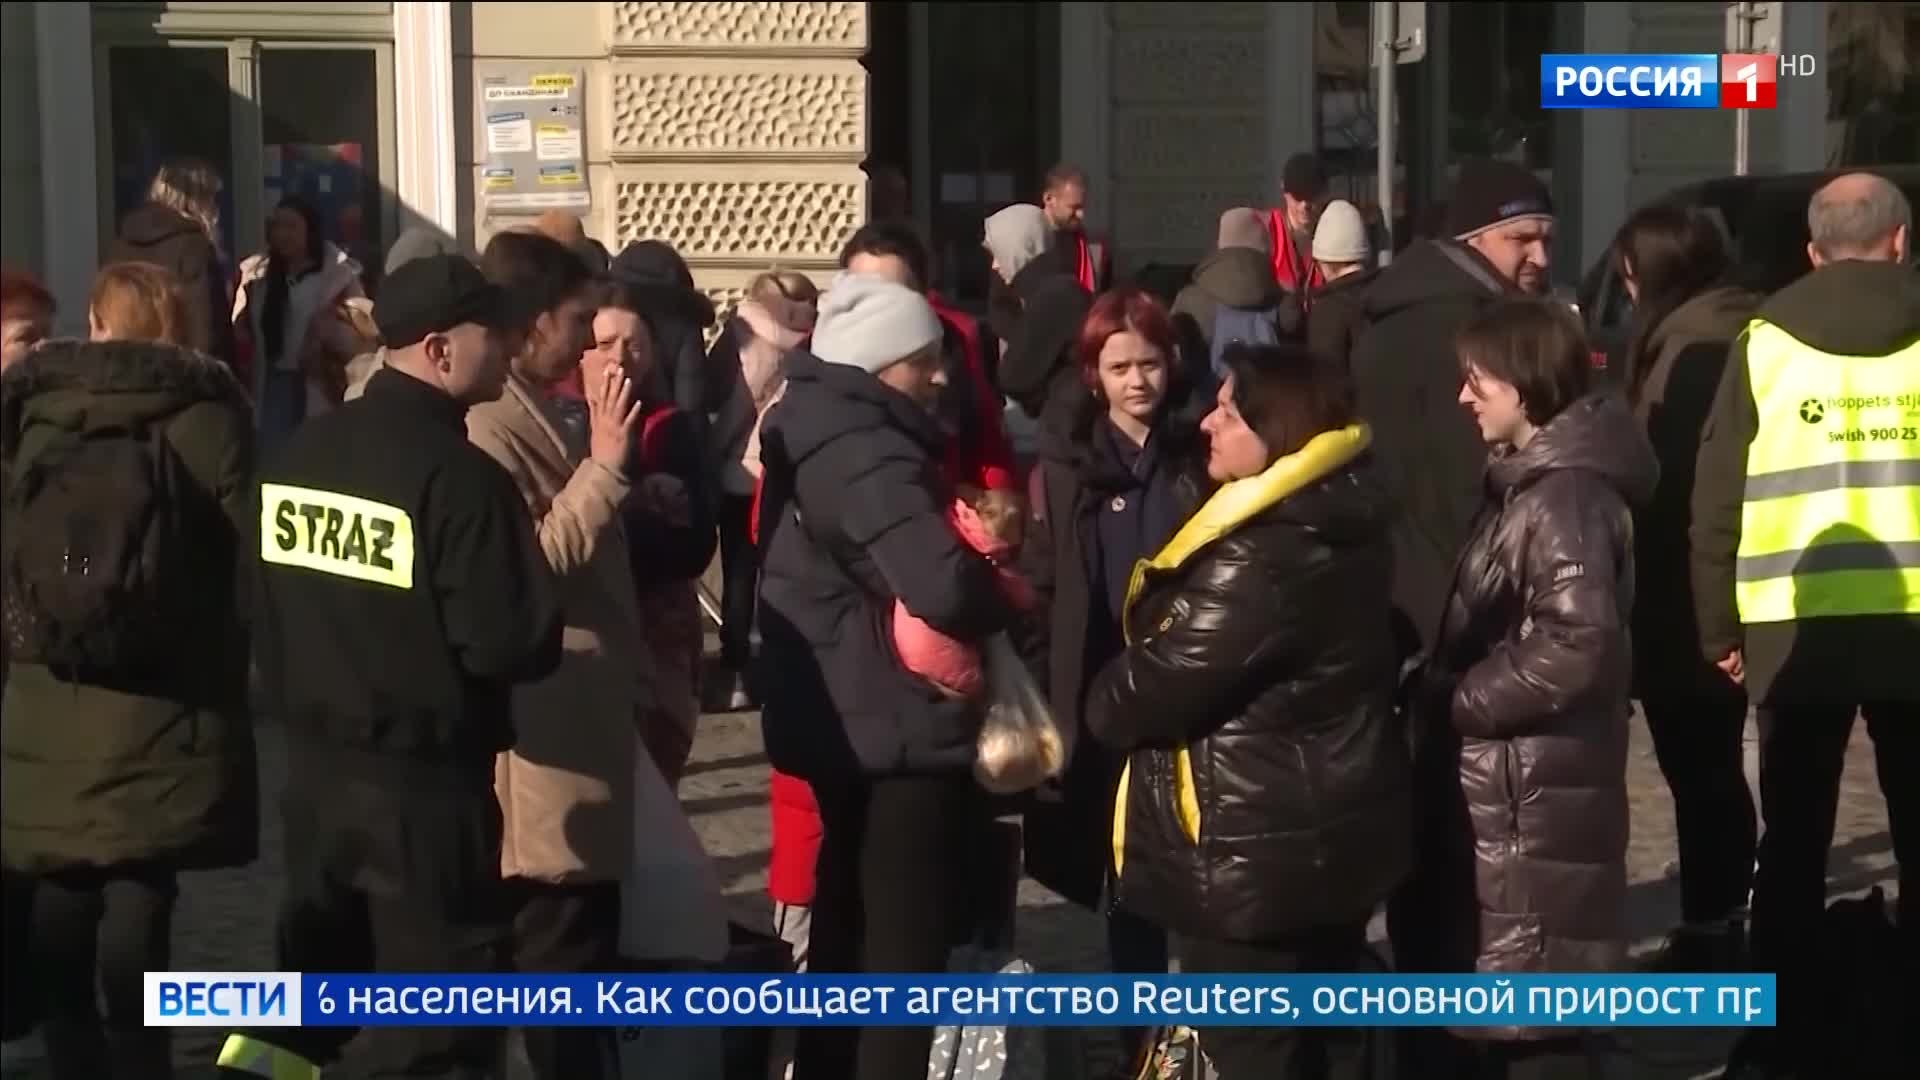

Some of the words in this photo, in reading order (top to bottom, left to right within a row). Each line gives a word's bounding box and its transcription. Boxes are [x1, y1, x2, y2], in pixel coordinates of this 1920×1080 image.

[1828, 427, 1865, 443] Swish
[1870, 427, 1898, 442] 900
[1901, 427, 1918, 441] 25
